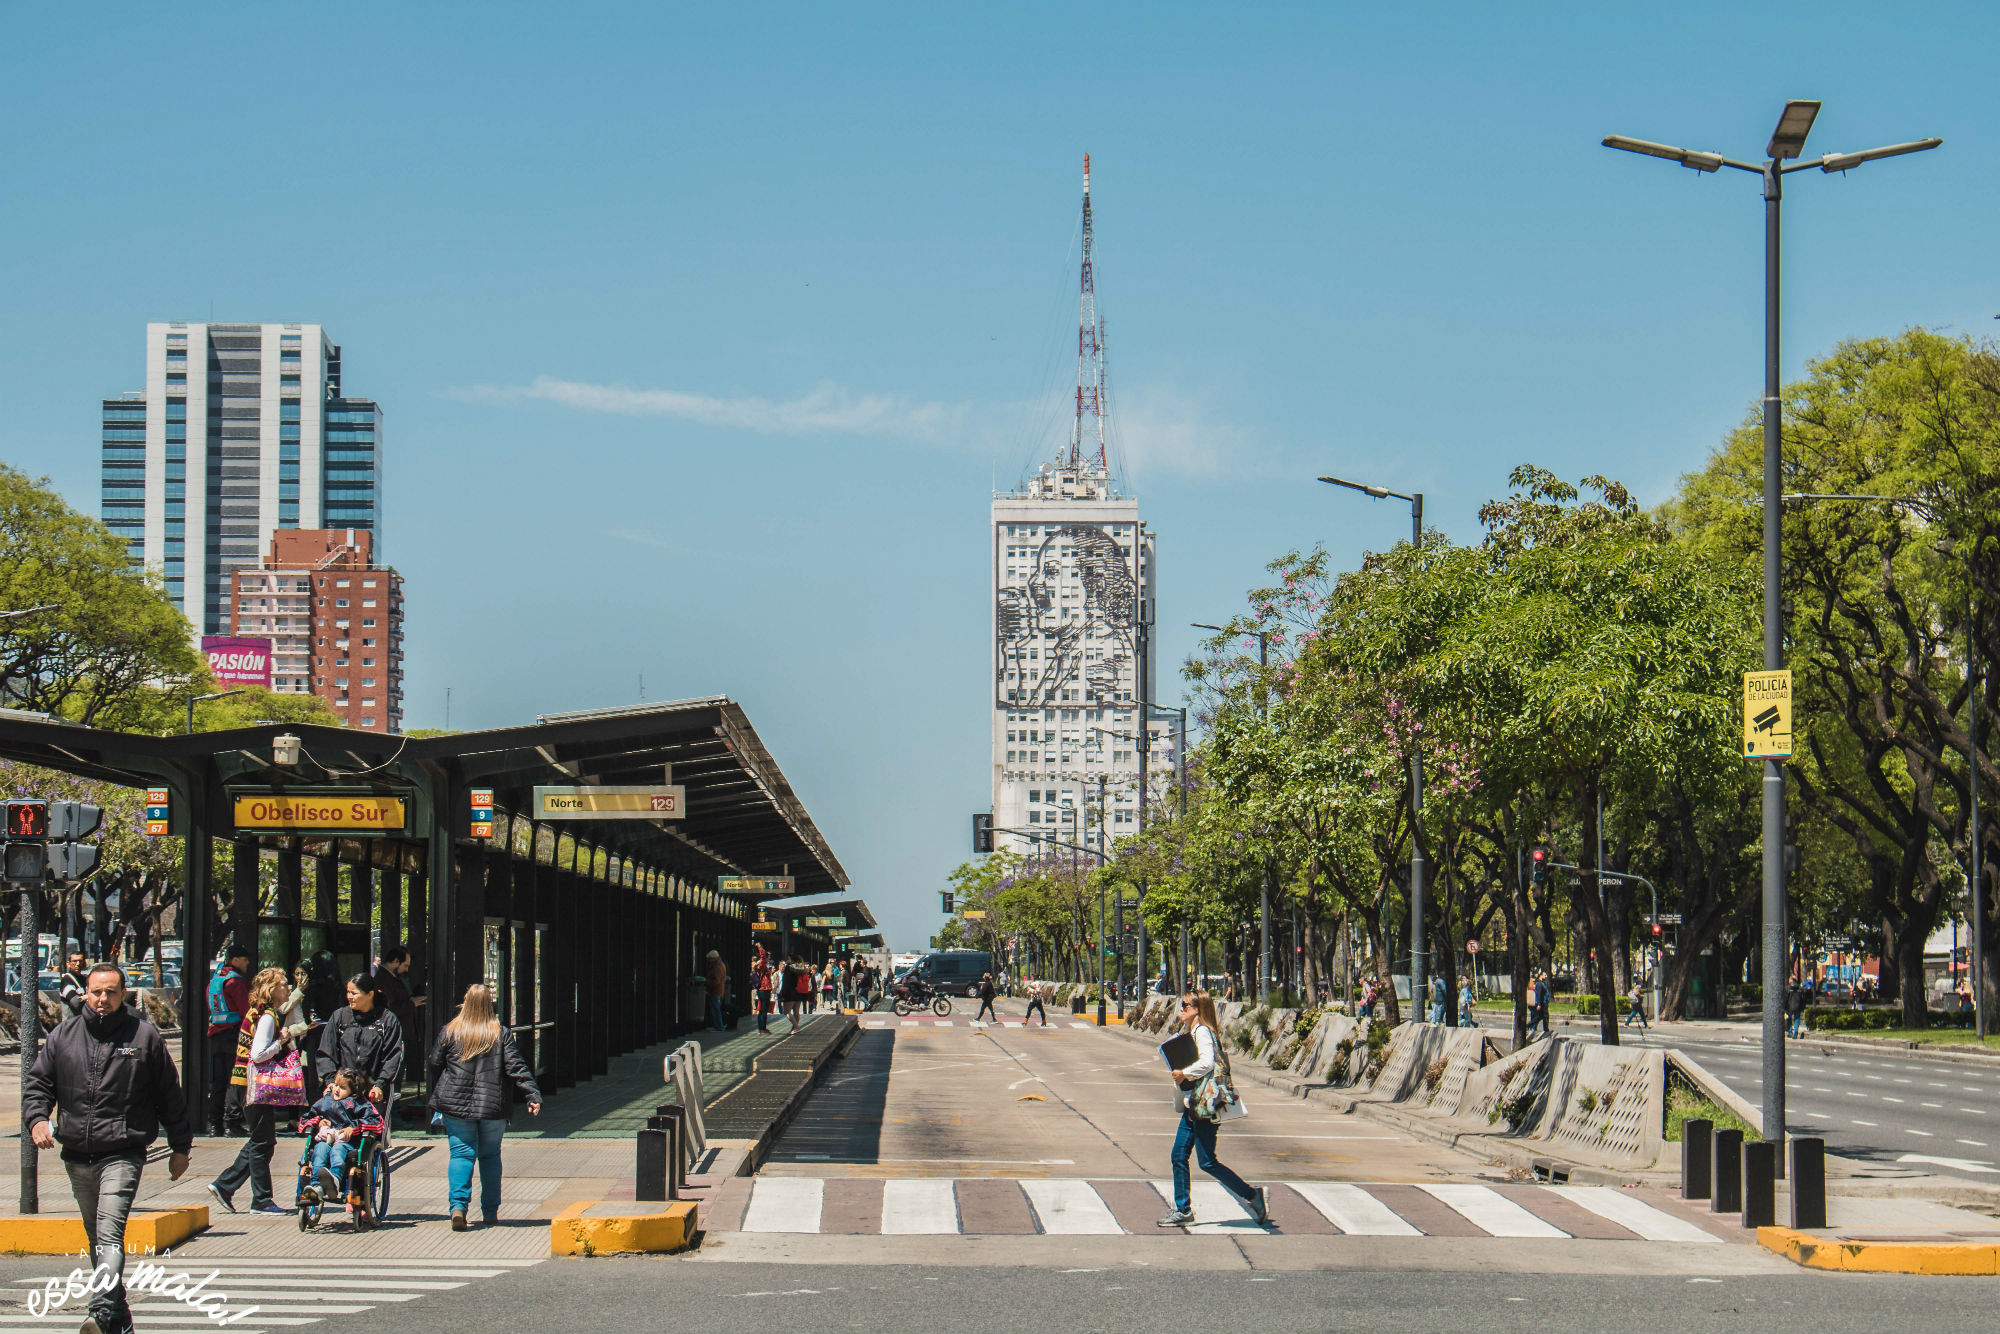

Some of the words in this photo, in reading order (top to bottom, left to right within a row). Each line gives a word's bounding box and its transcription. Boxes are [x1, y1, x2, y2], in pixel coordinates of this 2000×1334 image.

[208, 651, 266, 671] PASIÓN
[1748, 693, 1756, 701] DE
[1757, 692, 1765, 700] LA
[1766, 691, 1788, 700] CIUDAD
[149, 792, 165, 801] 129
[474, 794, 490, 803] 129
[551, 798, 583, 808] Norte
[651, 799, 674, 811] 129
[153, 808, 160, 817] 9
[251, 802, 343, 821] Obelisco
[351, 803, 388, 821] Sur
[479, 811, 486, 819] 9
[151, 824, 163, 833] 67
[476, 826, 488, 835] 67
[726, 880, 744, 888] Norte
